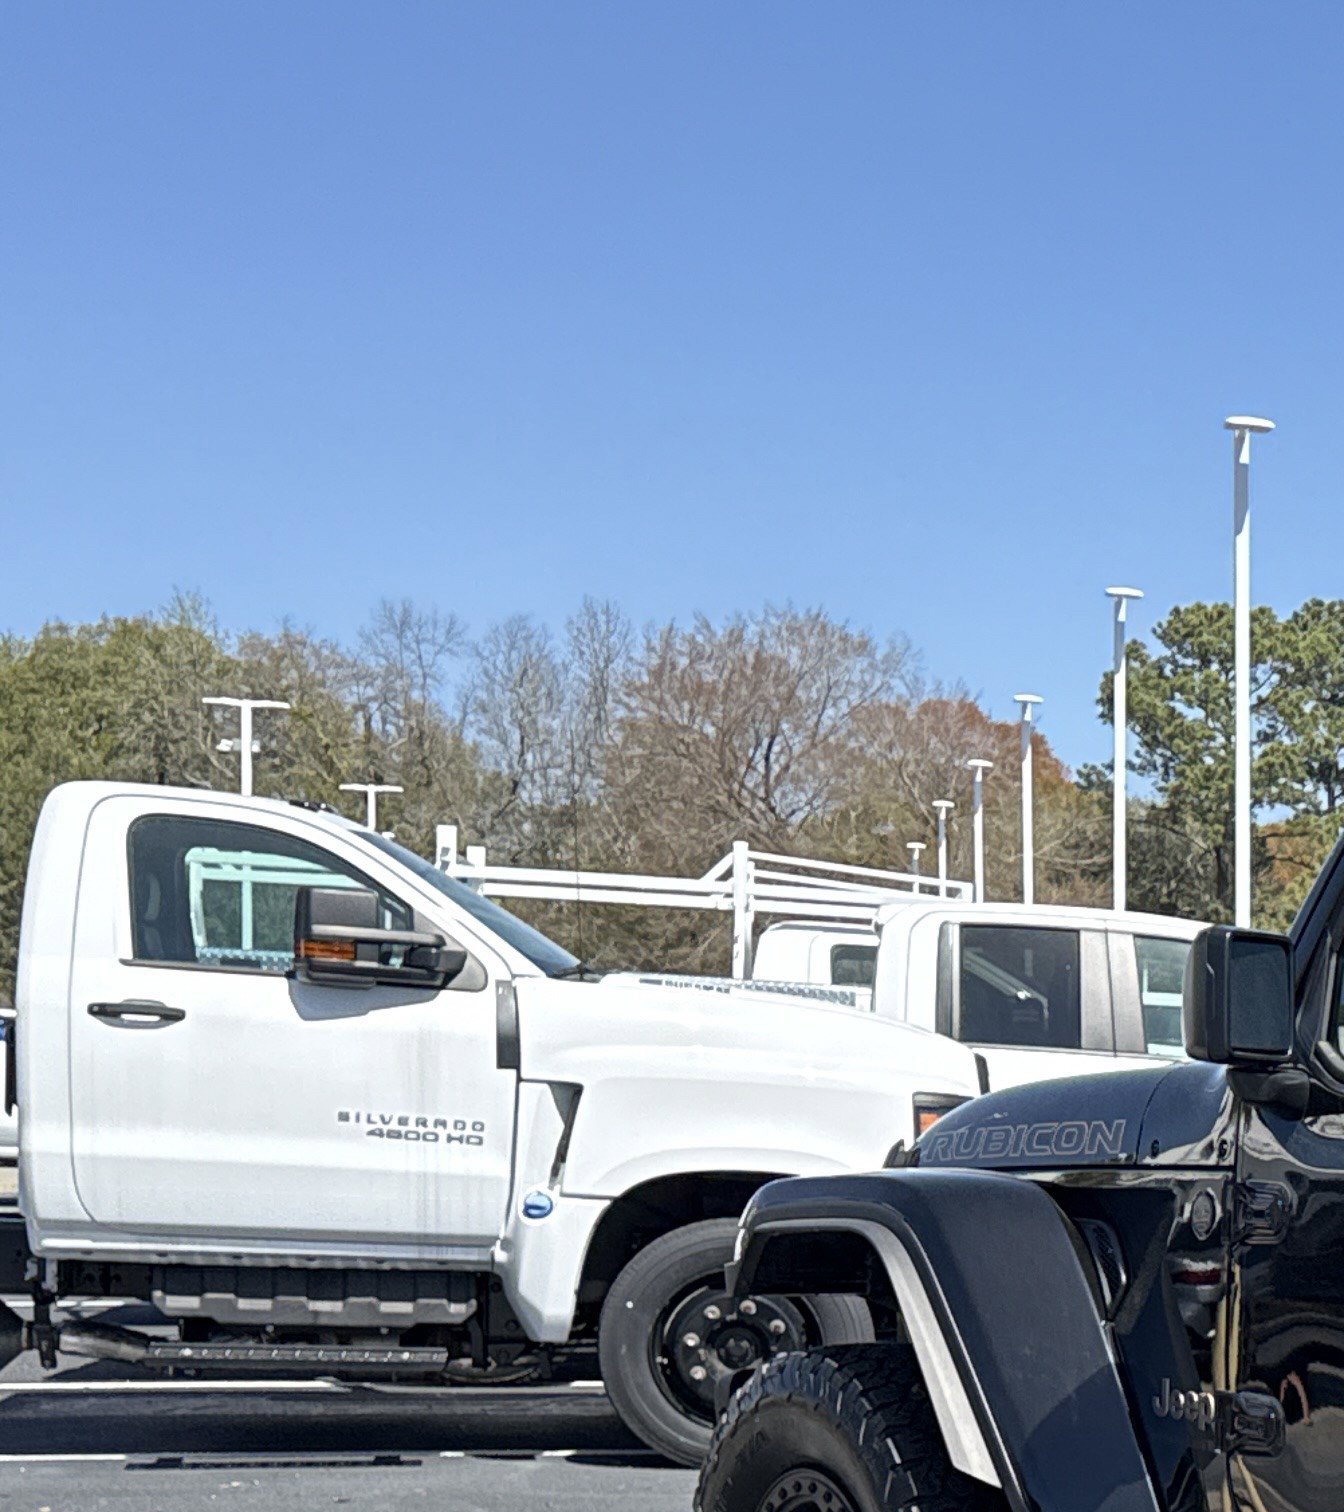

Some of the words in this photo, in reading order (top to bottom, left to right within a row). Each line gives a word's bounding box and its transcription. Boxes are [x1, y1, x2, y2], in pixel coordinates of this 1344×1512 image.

[337, 1111, 485, 1133] SILVERADO
[446, 1133, 484, 1147] HD
[923, 1118, 1127, 1163] RUBICON
[1151, 1377, 1216, 1432] Jeep
